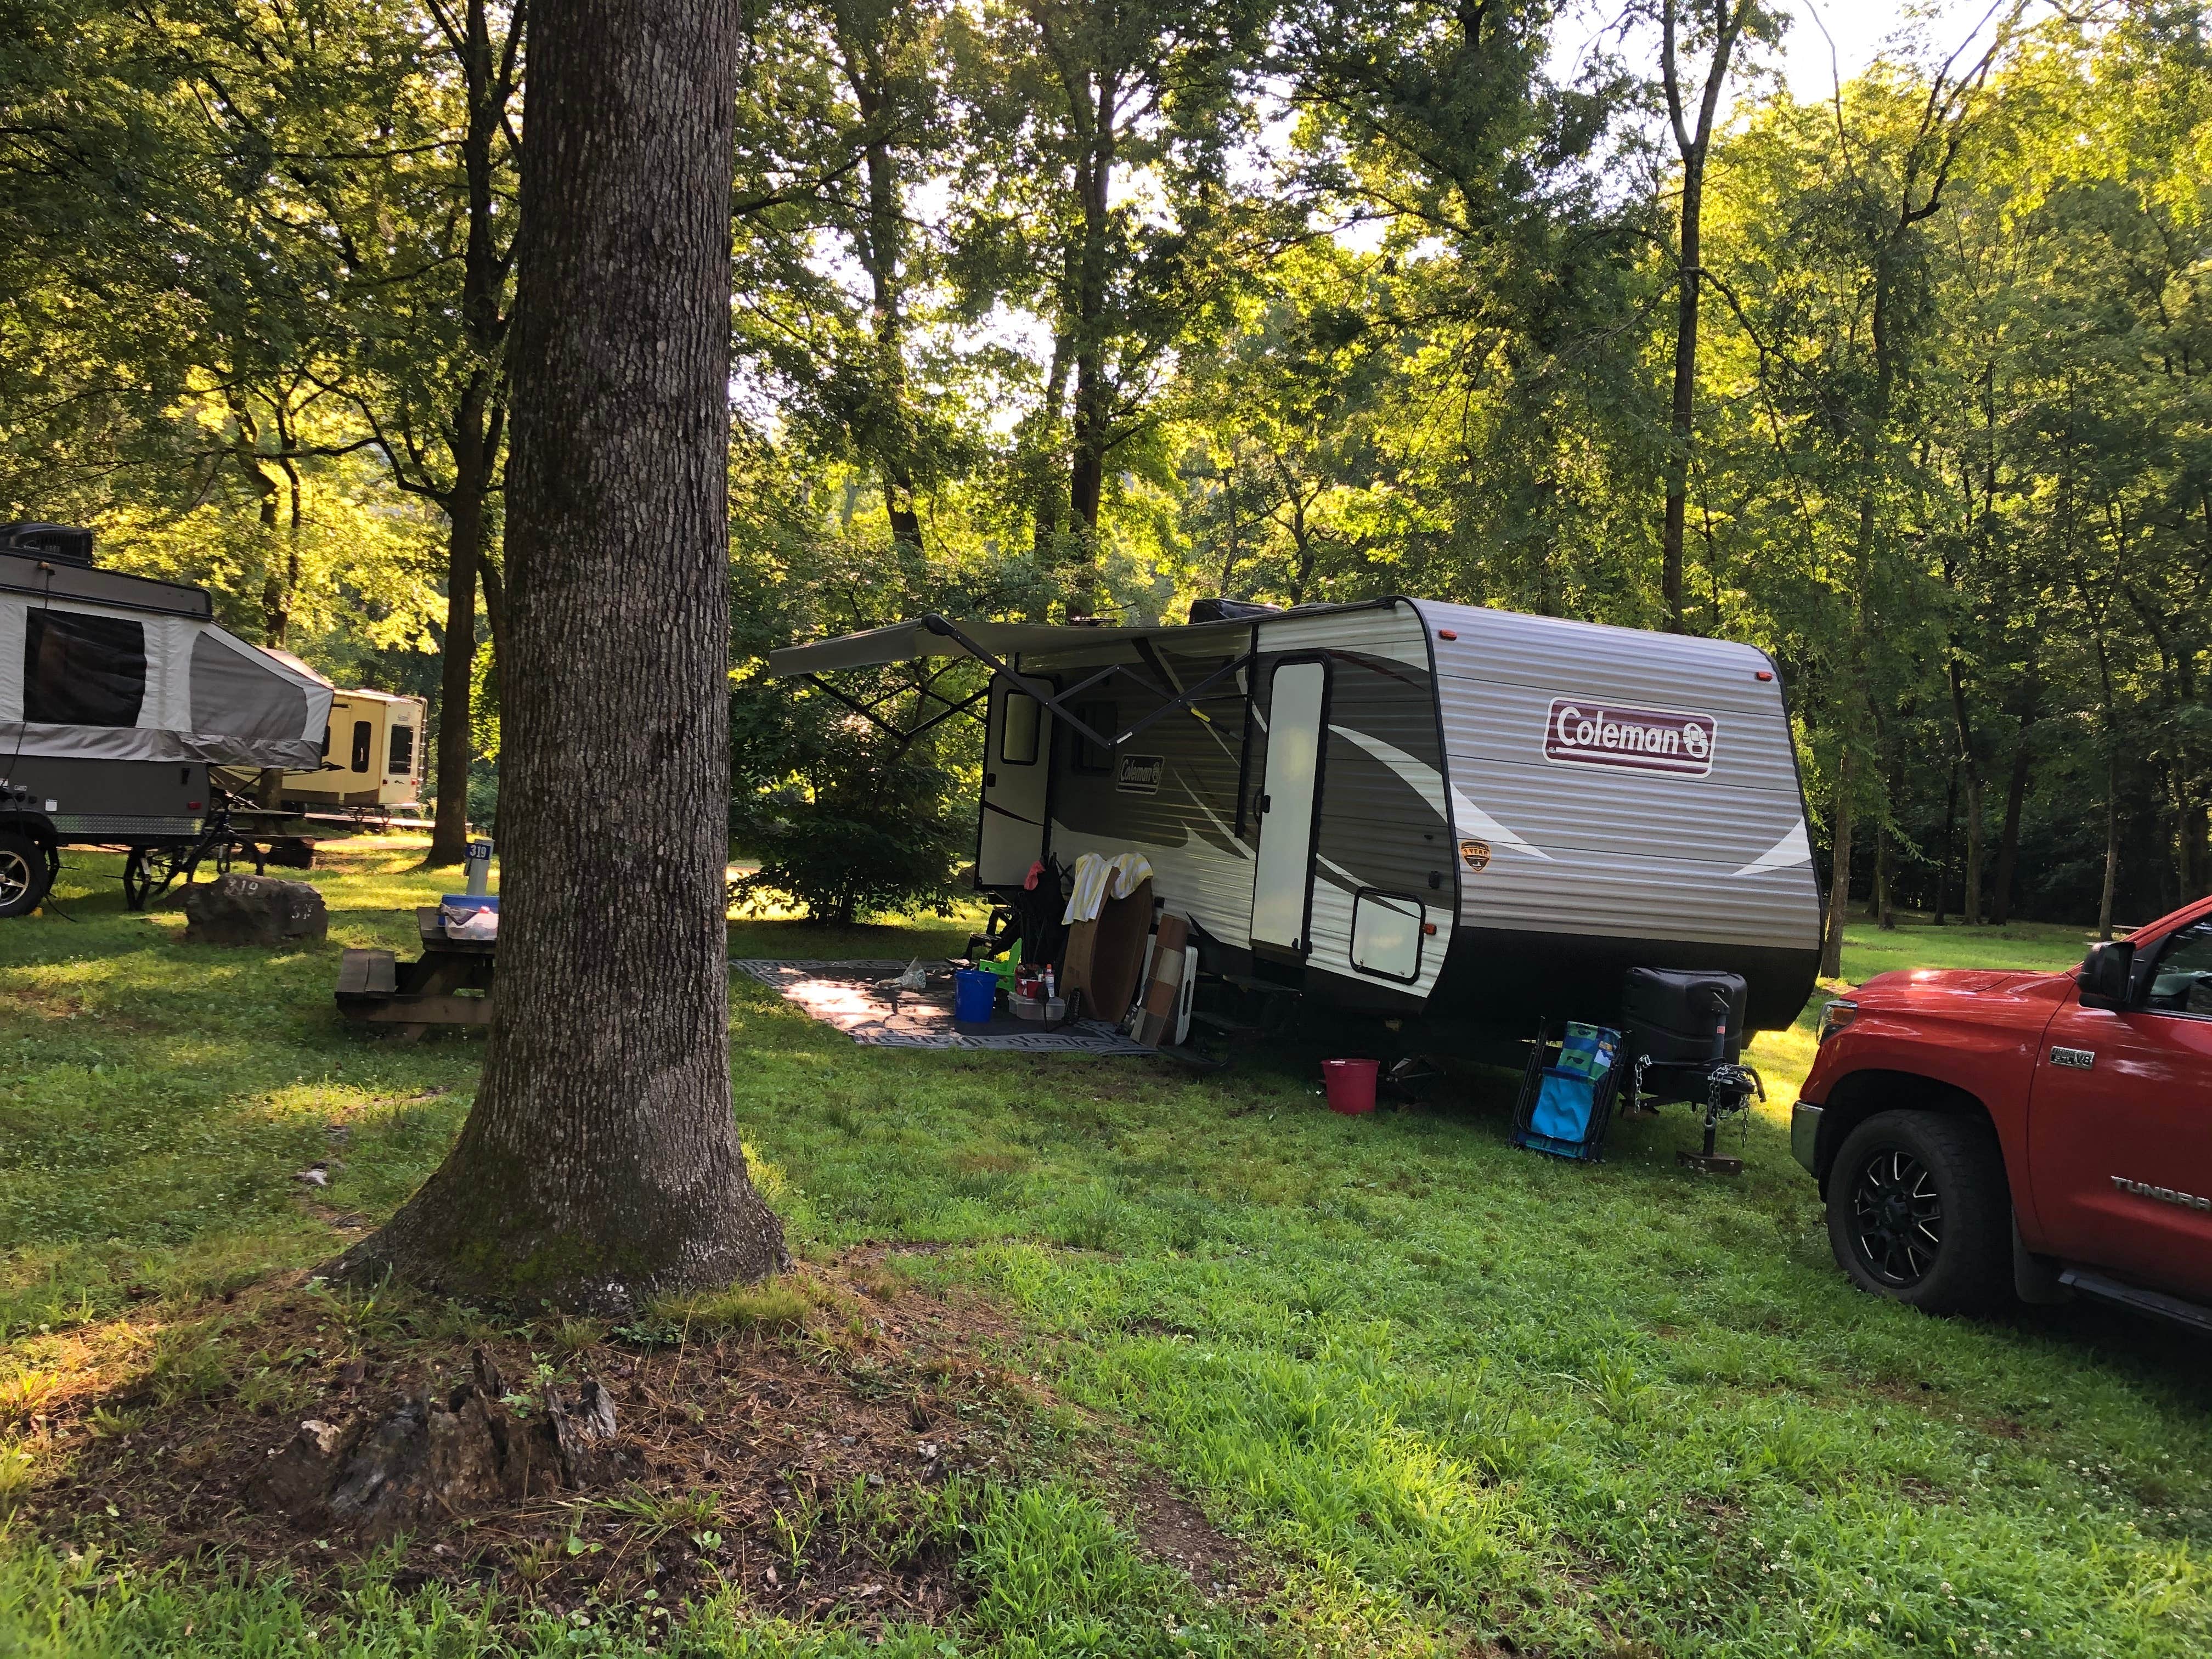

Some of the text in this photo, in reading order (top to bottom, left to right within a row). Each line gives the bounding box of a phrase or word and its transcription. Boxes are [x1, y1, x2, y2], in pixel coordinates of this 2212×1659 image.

[1556, 706, 1679, 755] Coleman
[1121, 759, 1152, 782] Coleman
[470, 844, 487, 857] 319
[2111, 1176, 2212, 1211] TUNDRA
